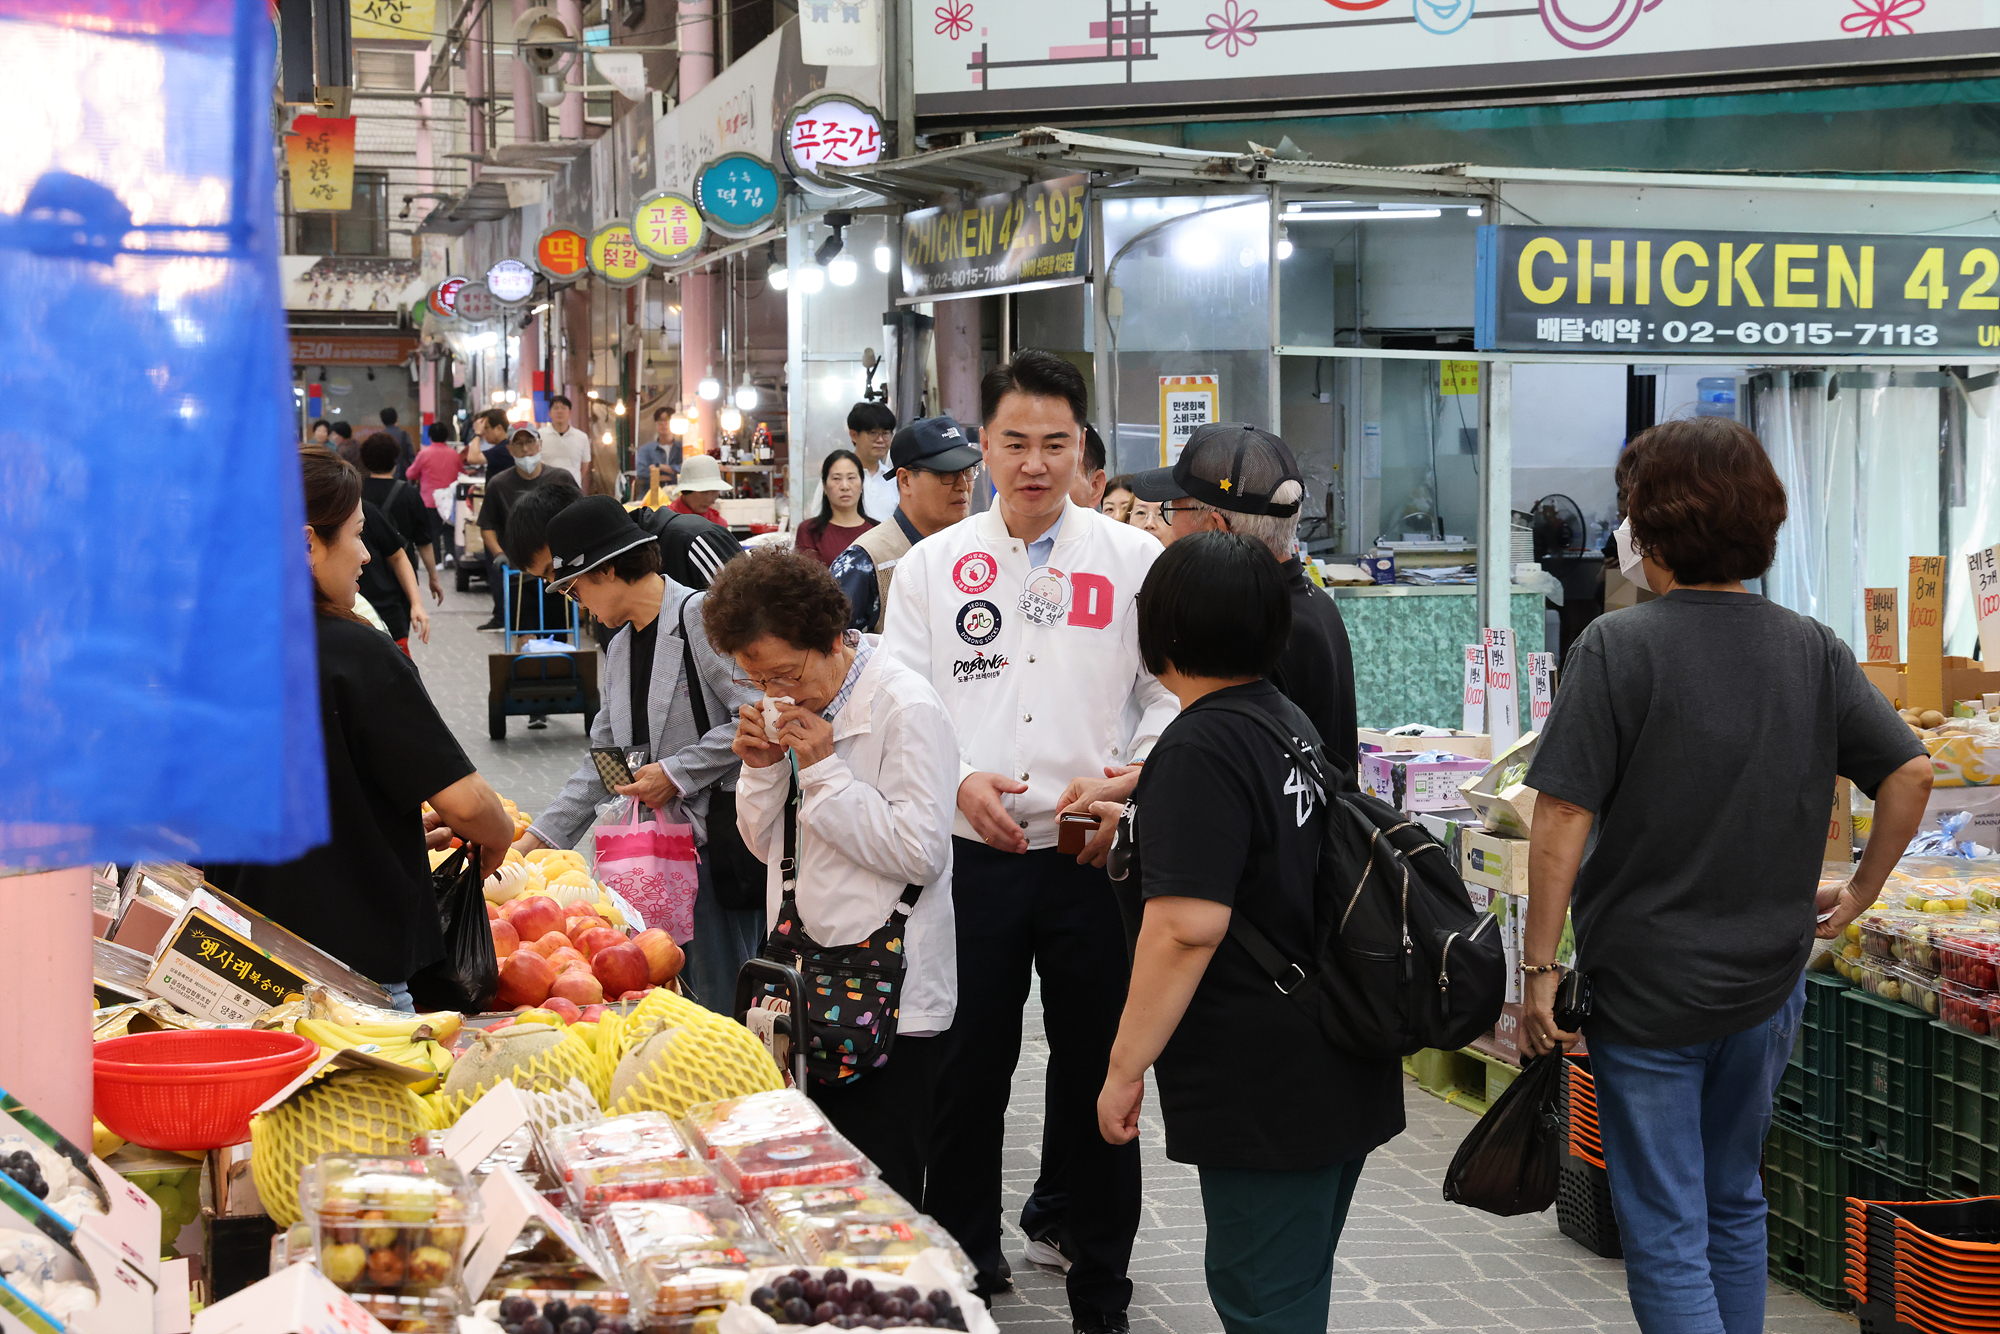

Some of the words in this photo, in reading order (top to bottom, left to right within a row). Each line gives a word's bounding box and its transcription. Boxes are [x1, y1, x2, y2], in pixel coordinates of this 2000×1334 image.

[792, 120, 880, 161] 푸줏간
[310, 184, 338, 200] 시장
[717, 187, 764, 208] 떡집
[650, 206, 688, 226] 고추
[905, 205, 994, 267] CHICKEN
[999, 185, 1085, 250] 42.195
[651, 227, 689, 246] 기름
[546, 235, 579, 272] 떡
[1517, 236, 1875, 309] CHICKEN
[1903, 247, 2000, 310] 42
[1662, 321, 1939, 347] 02-6015-7113
[1173, 401, 1206, 411] 민생회복
[1173, 413, 1206, 423] 소비쿠폰
[1916, 577, 1936, 600] 8개
[1979, 570, 1998, 591] 3개
[967, 601, 987, 610] SEOUL
[1027, 593, 1058, 612] 도봉구청장
[1067, 572, 1115, 630] D
[1020, 600, 1057, 625] 오언석
[960, 630, 984, 645] DOBONG
[985, 627, 1000, 643] SOCKS
[1485, 628, 1506, 647] 꿀포도
[957, 674, 974, 683] 도봉구
[249, 970, 285, 998] 복숭아
